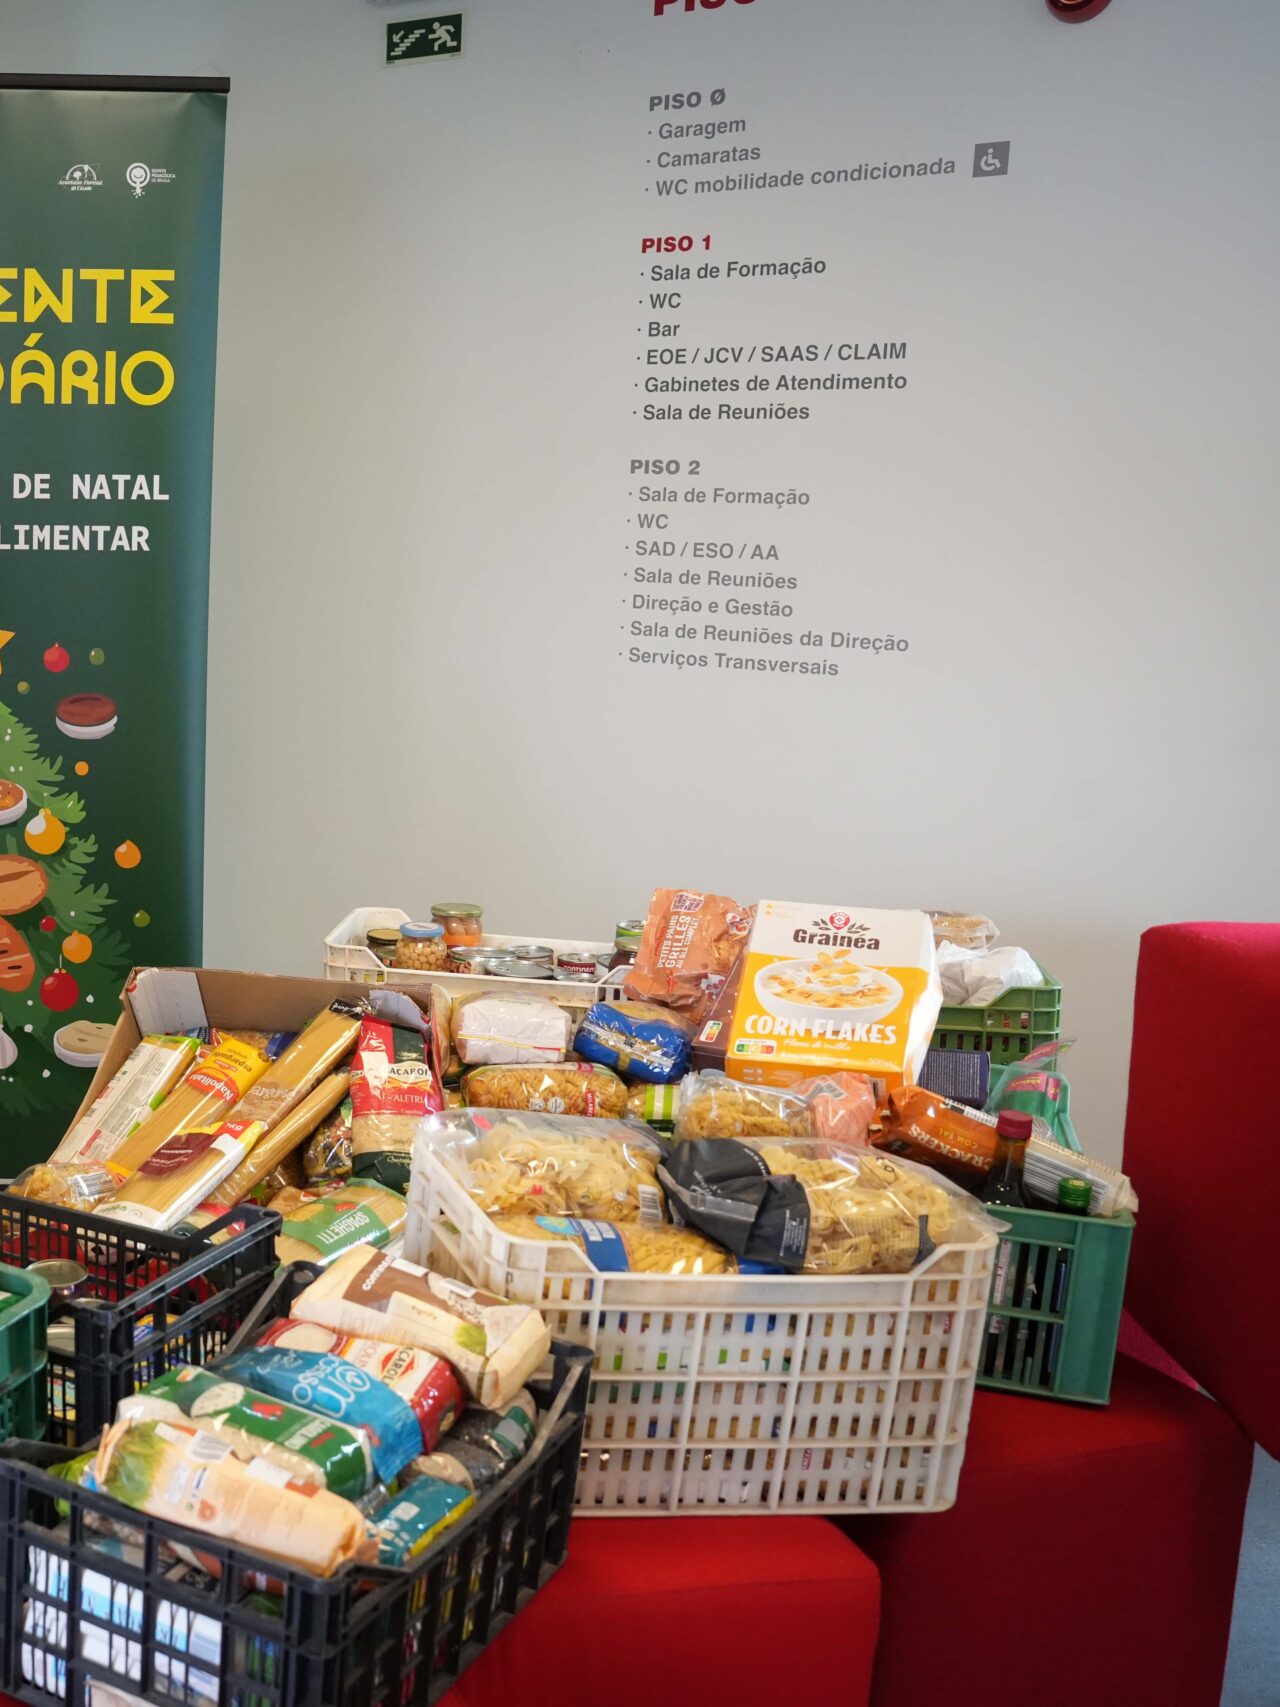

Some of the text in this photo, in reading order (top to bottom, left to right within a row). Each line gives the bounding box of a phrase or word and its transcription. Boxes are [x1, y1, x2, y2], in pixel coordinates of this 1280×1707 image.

[650, 92, 701, 111] PISO
[659, 120, 745, 139] Garagem
[658, 147, 760, 168] Camaratas
[656, 158, 955, 196] WC mobilidade condicionada
[642, 235, 710, 253] PISO 1
[651, 258, 826, 281] Sala de Formação
[650, 293, 681, 309] WC
[649, 322, 680, 337] Bar
[647, 349, 686, 364] EOE
[704, 347, 743, 363] JCV
[761, 345, 818, 362] SAAS
[838, 343, 906, 360] CLAIM
[645, 374, 907, 392] Gabinetes de Atendimento
[644, 403, 809, 420] Sala de Reuniões
[631, 460, 700, 475] PISO 2
[13, 474, 50, 498] DE
[73, 474, 169, 500] NATAL
[639, 487, 809, 509] Sala de Formação
[638, 514, 668, 529] WC
[636, 541, 675, 556] SAD
[693, 543, 733, 558] ESO
[751, 545, 778, 560] AA
[634, 568, 797, 589] Sala de Reuniões
[633, 595, 792, 617] Direção e Gestão
[631, 621, 908, 654] Sala de Reuniões da Direção
[629, 647, 838, 675] Serviços Transversais
[793, 928, 880, 950] Grainéa
[744, 1014, 896, 1045] CORN FLAKES
[317, 1211, 371, 1244] SPAGHETTI
